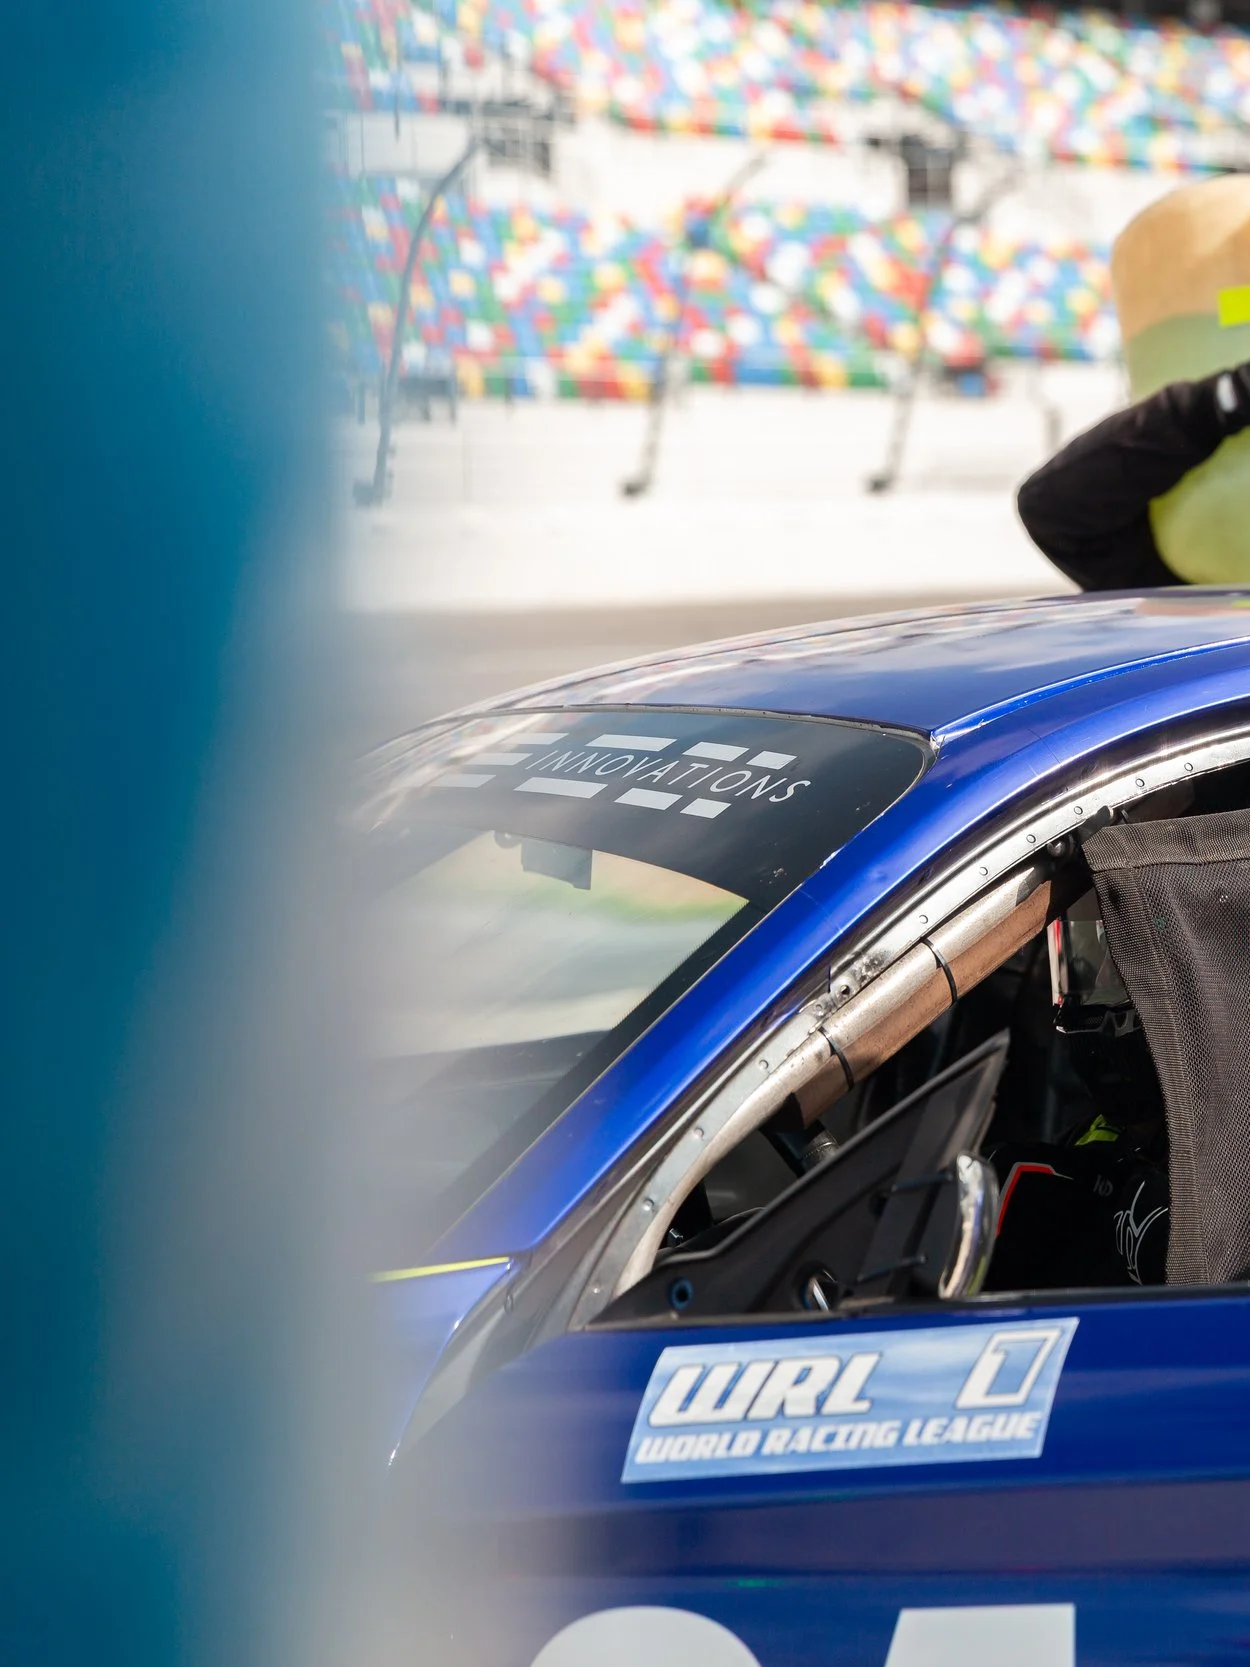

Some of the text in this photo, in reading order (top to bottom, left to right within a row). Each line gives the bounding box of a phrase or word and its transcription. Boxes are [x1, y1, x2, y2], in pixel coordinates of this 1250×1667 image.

[524, 749, 811, 803] INNOVATIONS
[649, 1353, 883, 1427] WRL
[635, 1412, 1041, 1464] WORLD RACING LEAGUE
